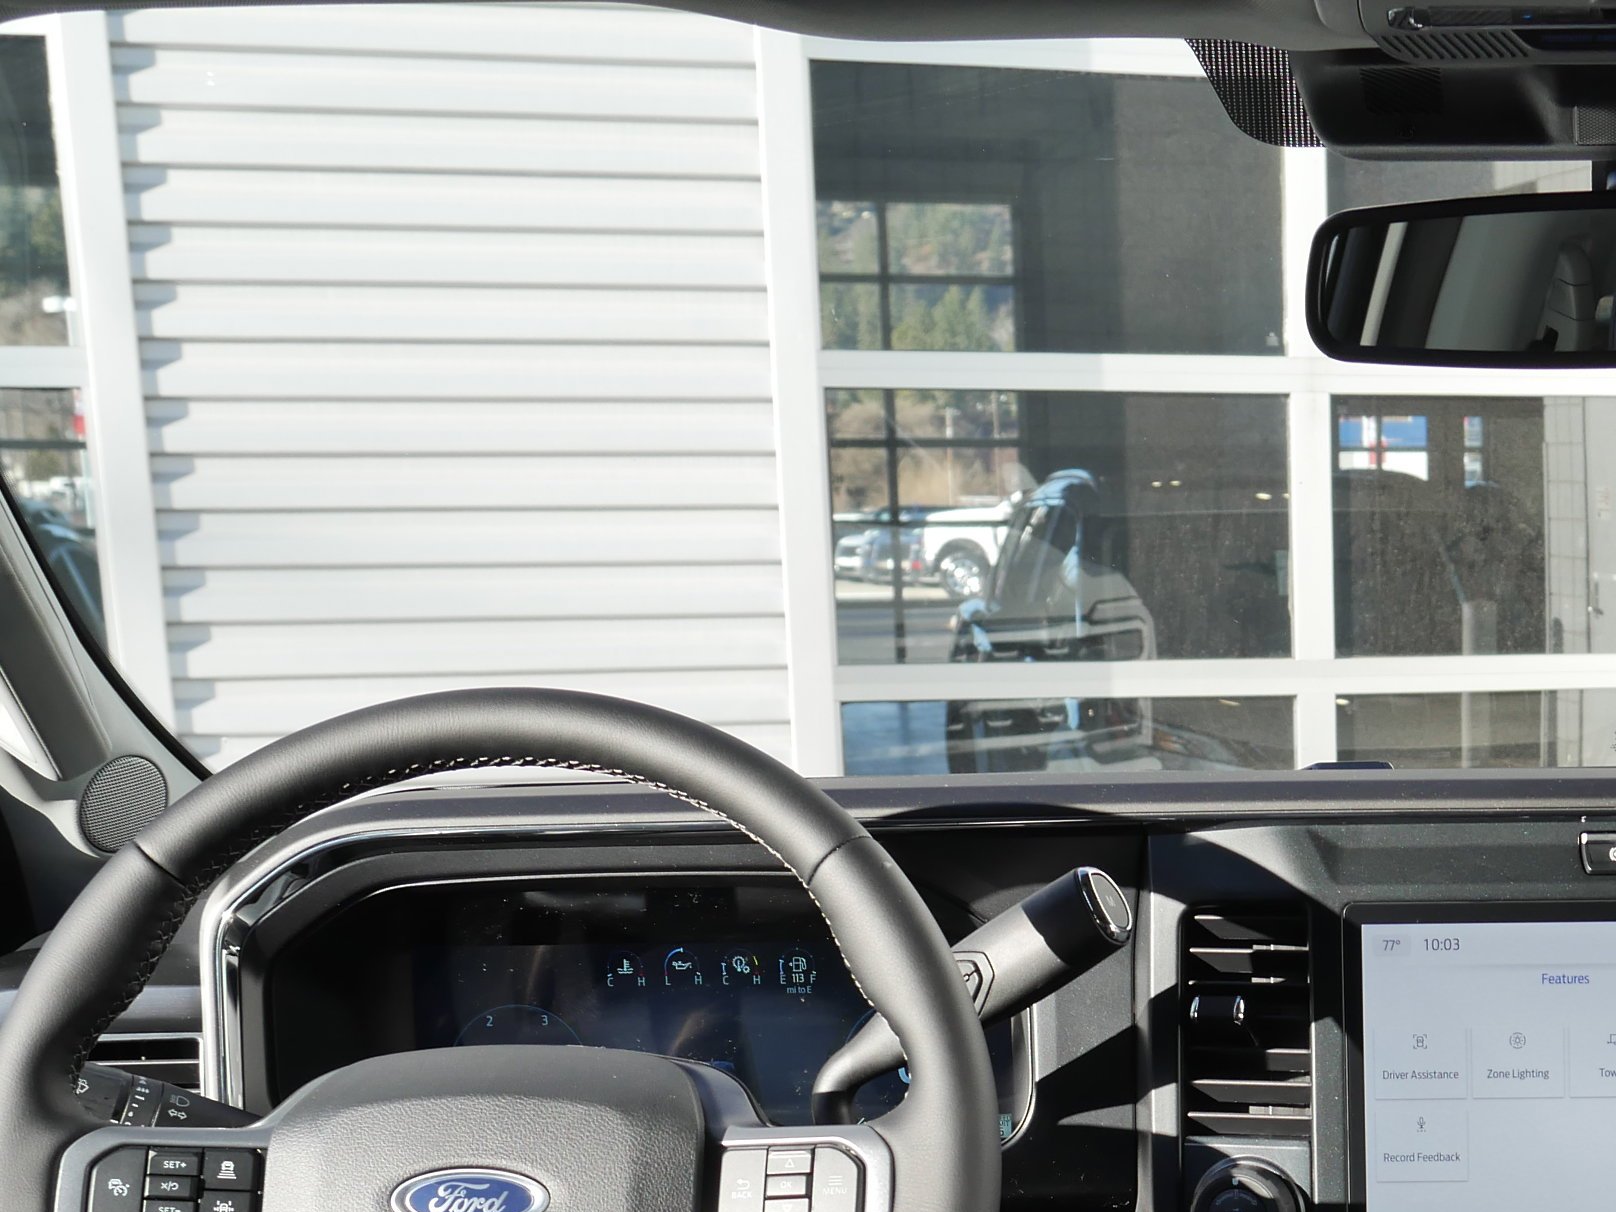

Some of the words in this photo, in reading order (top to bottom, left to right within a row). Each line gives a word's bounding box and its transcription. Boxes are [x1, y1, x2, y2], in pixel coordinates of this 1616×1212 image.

[1382, 939, 1401, 952] 77°
[1423, 938, 1460, 951] 10:03
[607, 977, 614, 987] C
[638, 977, 645, 986] H
[665, 976, 671, 986] L
[695, 976, 702, 985] H
[722, 976, 729, 985] C
[753, 976, 760, 985] H
[780, 975, 786, 985] E
[792, 973, 804, 983] 113
[810, 975, 816, 984] F
[1541, 973, 1590, 985] Features
[787, 986, 797, 994] mi
[798, 986, 806, 994] to
[486, 1016, 493, 1027] 2
[542, 1015, 549, 1026] 3
[1382, 1069, 1409, 1080] Driver
[1411, 1069, 1459, 1080] Assistance
[1486, 1069, 1510, 1079] Zone
[1512, 1068, 1550, 1081] Lighting
[1383, 1152, 1415, 1163] Record
[1417, 1151, 1461, 1162] Feedback
[731, 1191, 752, 1200] BACK
[823, 1187, 848, 1195] MENU
